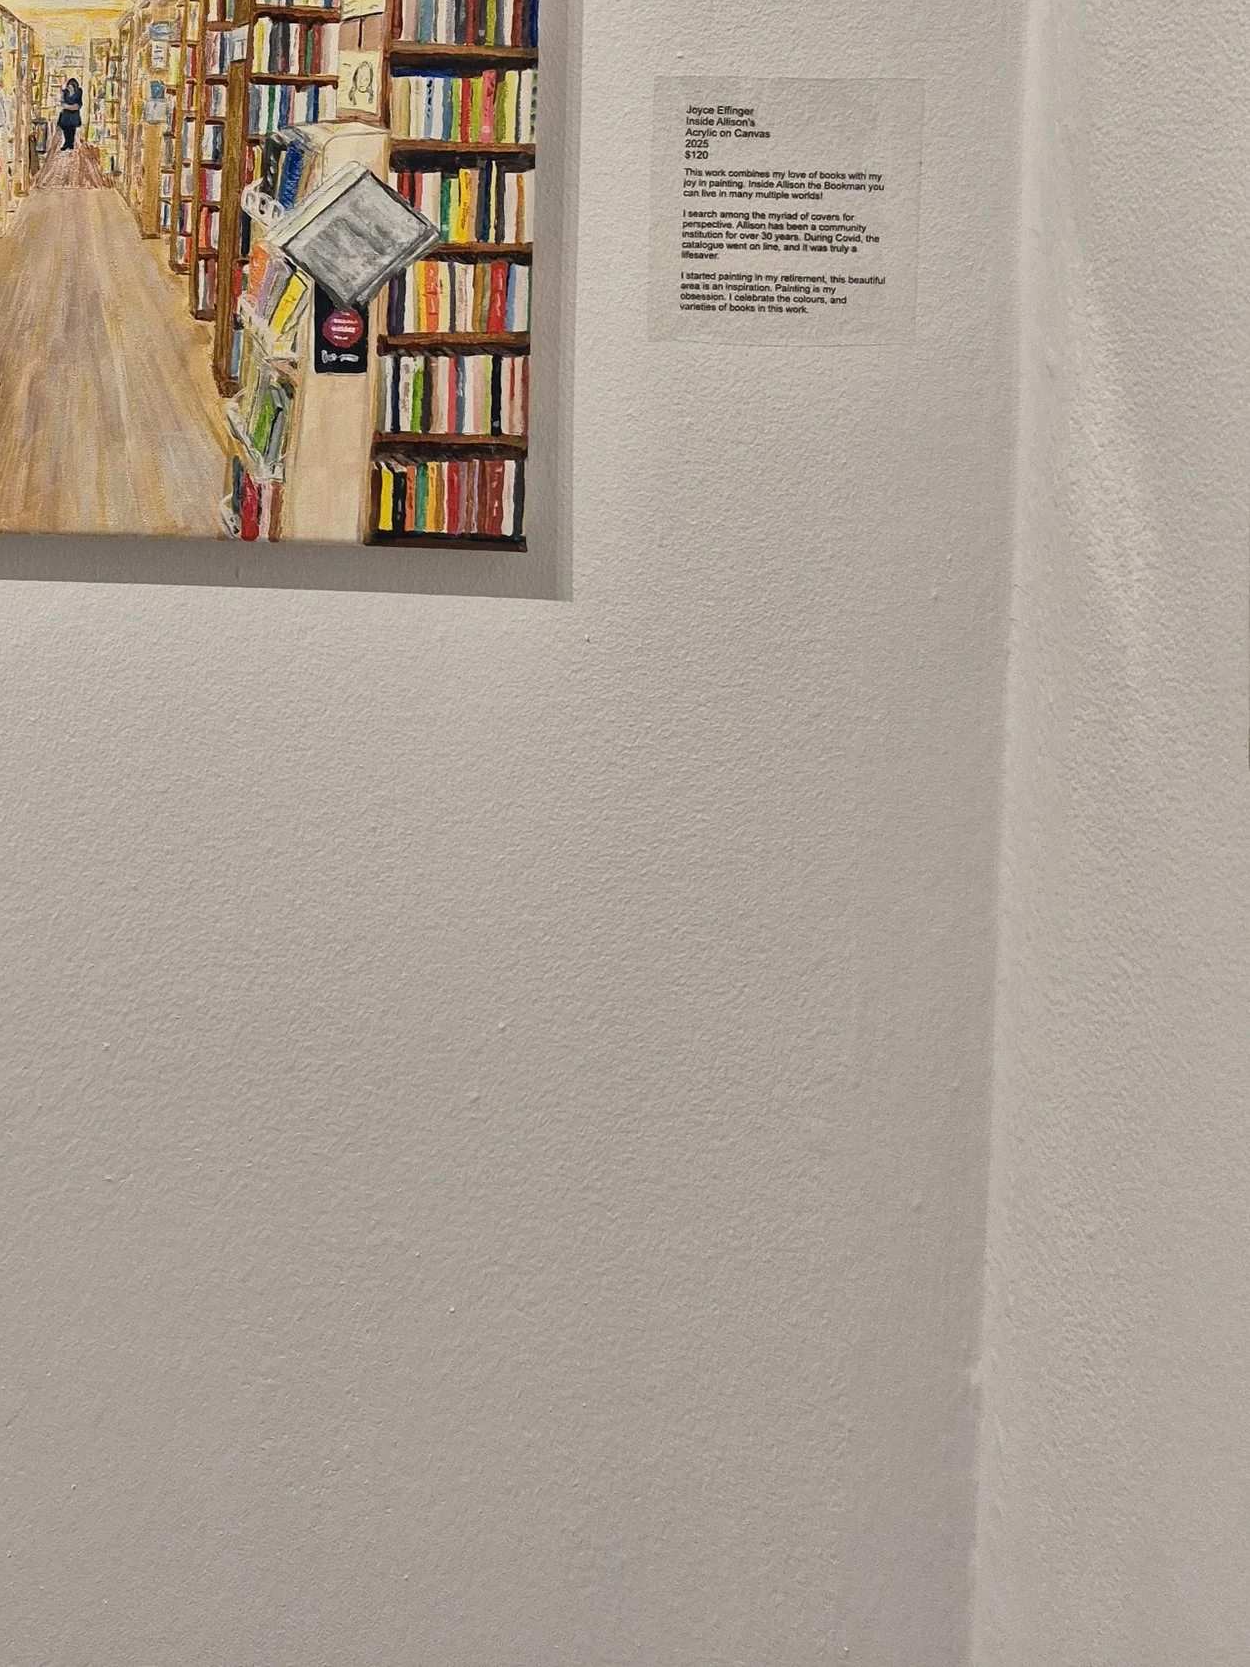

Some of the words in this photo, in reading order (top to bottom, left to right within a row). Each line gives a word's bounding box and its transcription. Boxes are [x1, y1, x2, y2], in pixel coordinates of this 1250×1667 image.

[686, 105, 714, 116] Joyce
[716, 105, 754, 117] Effinger
[686, 116, 714, 126] Inside
[715, 117, 756, 127] Allison's
[684, 127, 717, 138] Acrylic
[734, 128, 770, 138] Canvas
[684, 138, 709, 148] 2025
[684, 150, 708, 159] $120
[684, 167, 703, 176] This
[704, 168, 726, 177] work
[728, 169, 770, 178] combines
[772, 171, 785, 180] my
[787, 170, 806, 178] love
[808, 170, 818, 179] of
[819, 171, 846, 180] books
[847, 170, 866, 180] with
[868, 173, 882, 182] my
[682, 178, 696, 188] joy
[698, 178, 707, 186] in
[748, 180, 775, 188] Inside
[775, 180, 805, 189] Allison
[807, 180, 821, 189] the
[823, 181, 866, 190] Bookman
[867, 181, 884, 192] you
[701, 189, 716, 197] live
[718, 189, 727, 197] in
[728, 191, 753, 199] many
[755, 190, 789, 200] multiple
[790, 191, 823, 200] worlds!
[729, 293, 732, 301] I
[734, 293, 774, 302] celebrate
[776, 294, 790, 303] the
[792, 295, 827, 304] colours,
[830, 296, 847, 304] and
[679, 302, 716, 311] varieties
[718, 303, 727, 311] of
[729, 303, 755, 312] books
[757, 304, 765, 312] in
[767, 304, 783, 313] this
[785, 305, 808, 313] work.
